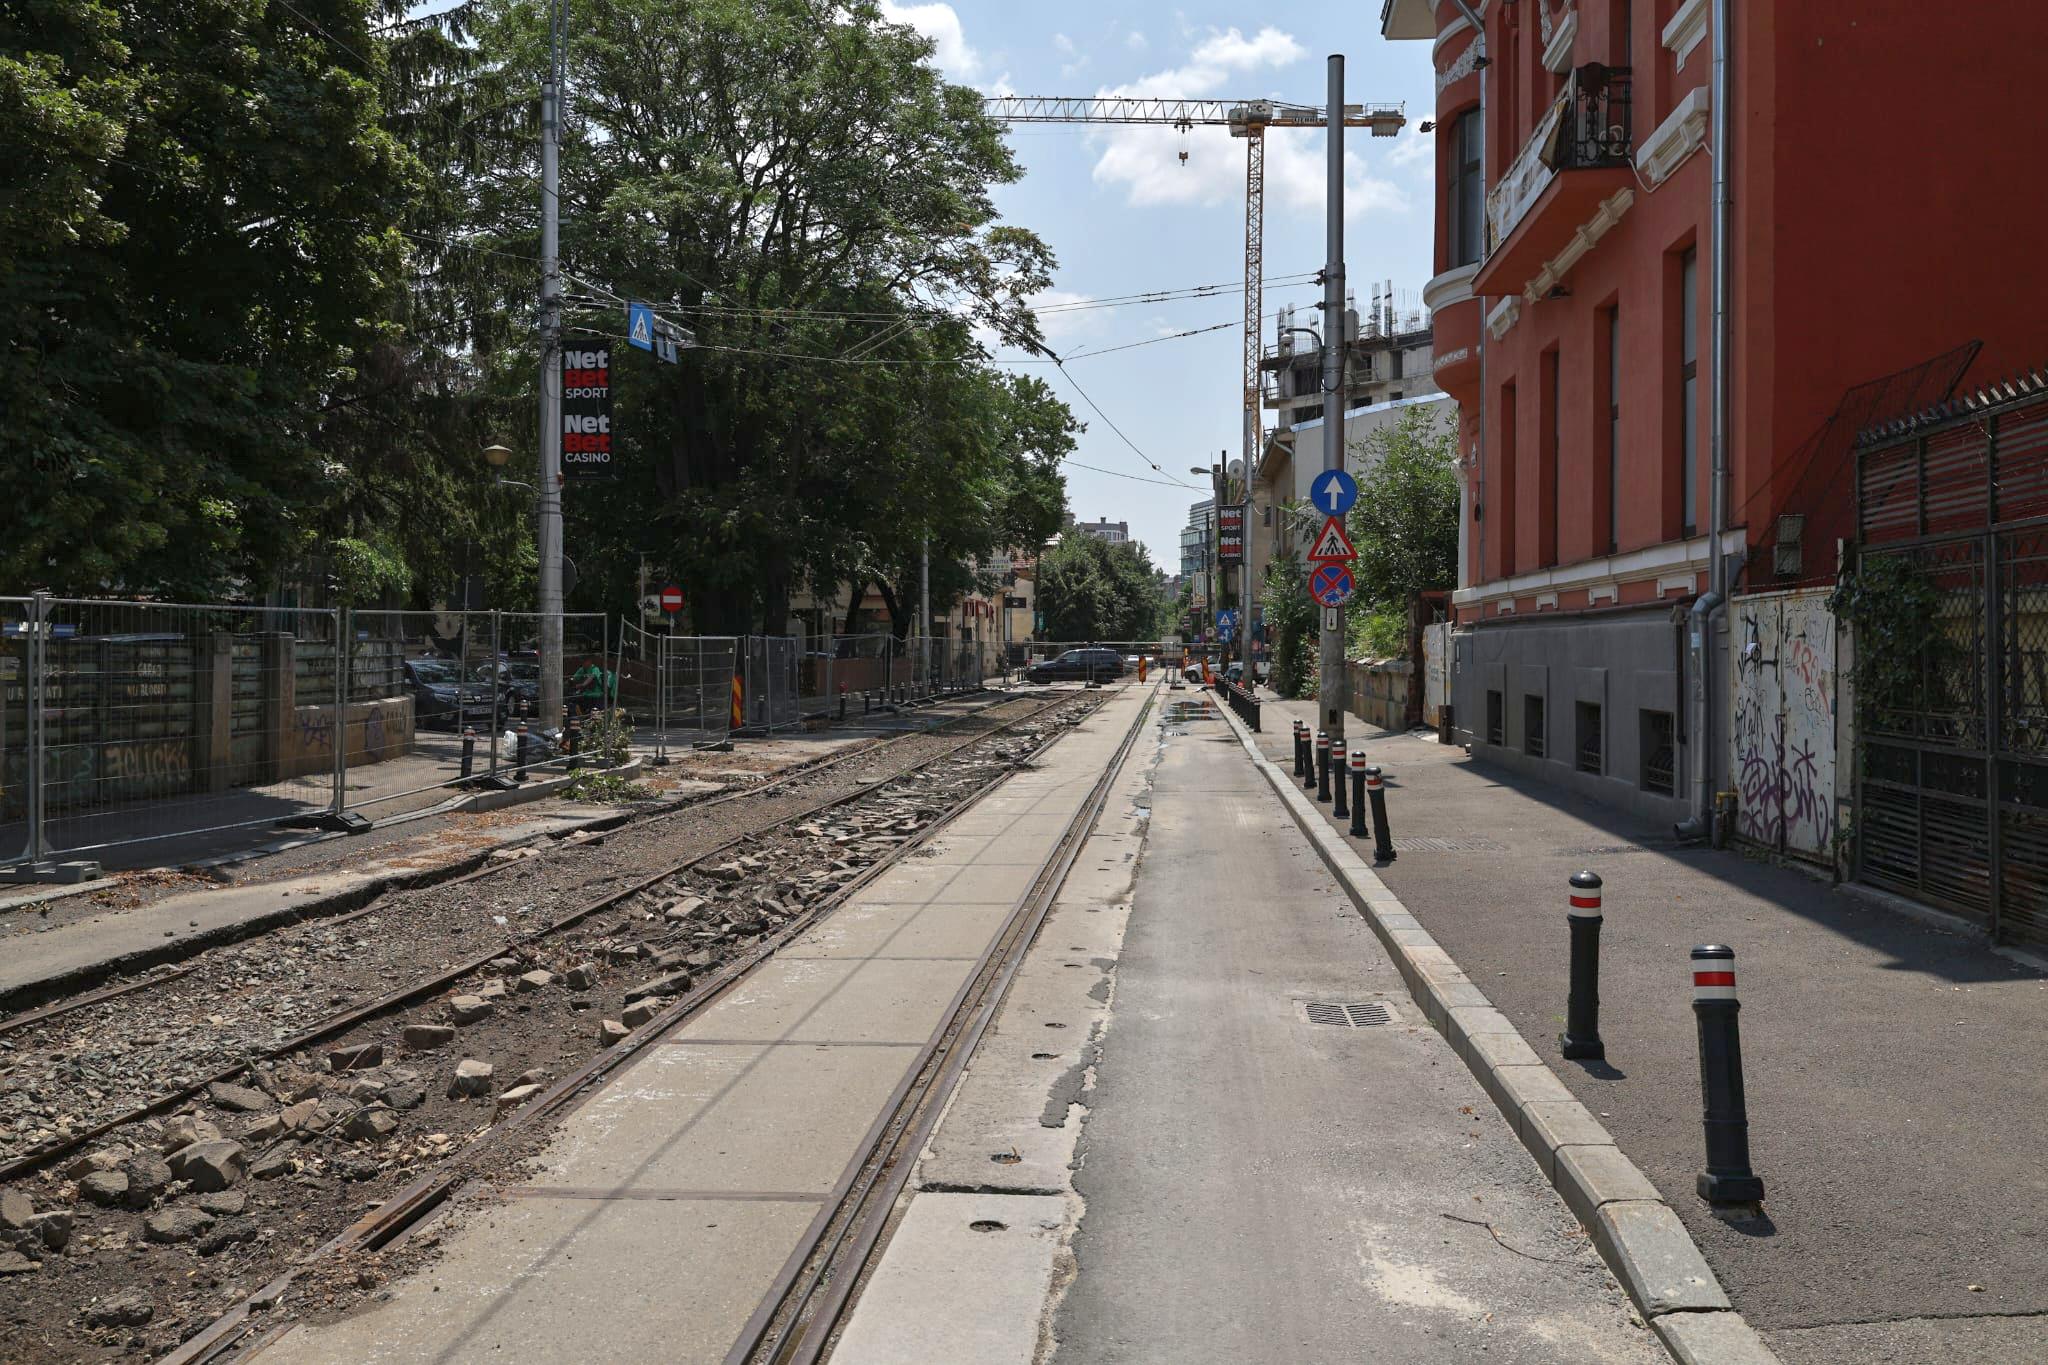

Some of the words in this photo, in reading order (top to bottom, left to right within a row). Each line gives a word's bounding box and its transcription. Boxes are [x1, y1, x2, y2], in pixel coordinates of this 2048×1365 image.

[565, 350, 608, 369] Net
[565, 369, 608, 387] Bet
[565, 388, 608, 399] SPORT
[564, 414, 610, 433] Net
[564, 433, 610, 452] Bet
[565, 452, 610, 463] CASINO
[1220, 509, 1242, 518] Net
[1220, 536, 1242, 545] Net
